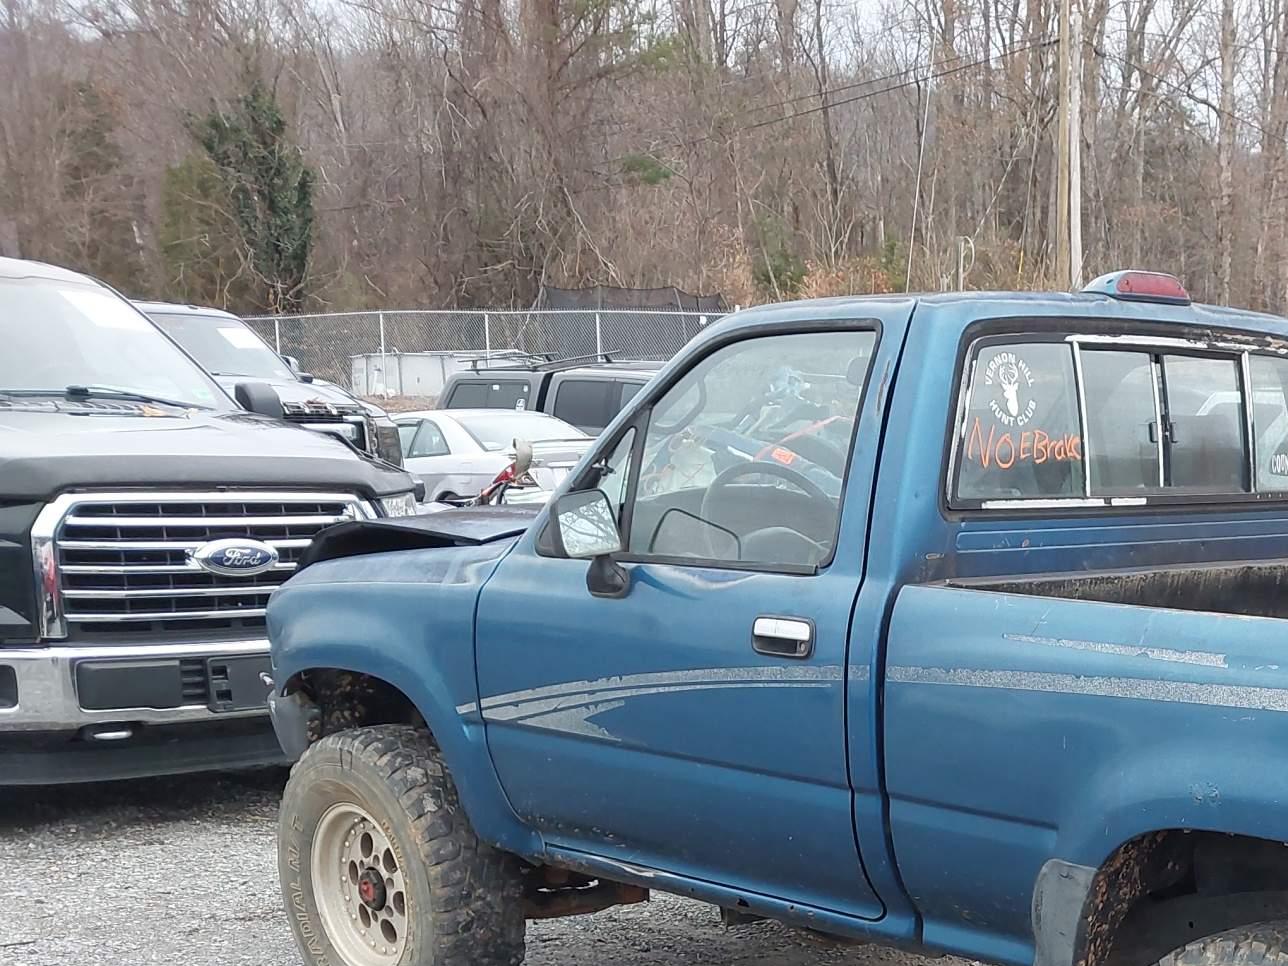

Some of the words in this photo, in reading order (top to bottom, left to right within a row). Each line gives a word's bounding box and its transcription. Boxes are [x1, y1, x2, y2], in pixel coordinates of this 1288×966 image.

[985, 352, 1016, 385] VERNON
[1018, 360, 1035, 387] HILL
[989, 399, 1016, 426] HUNT
[1016, 399, 1036, 426] CLUB
[222, 548, 261, 566] Ford
